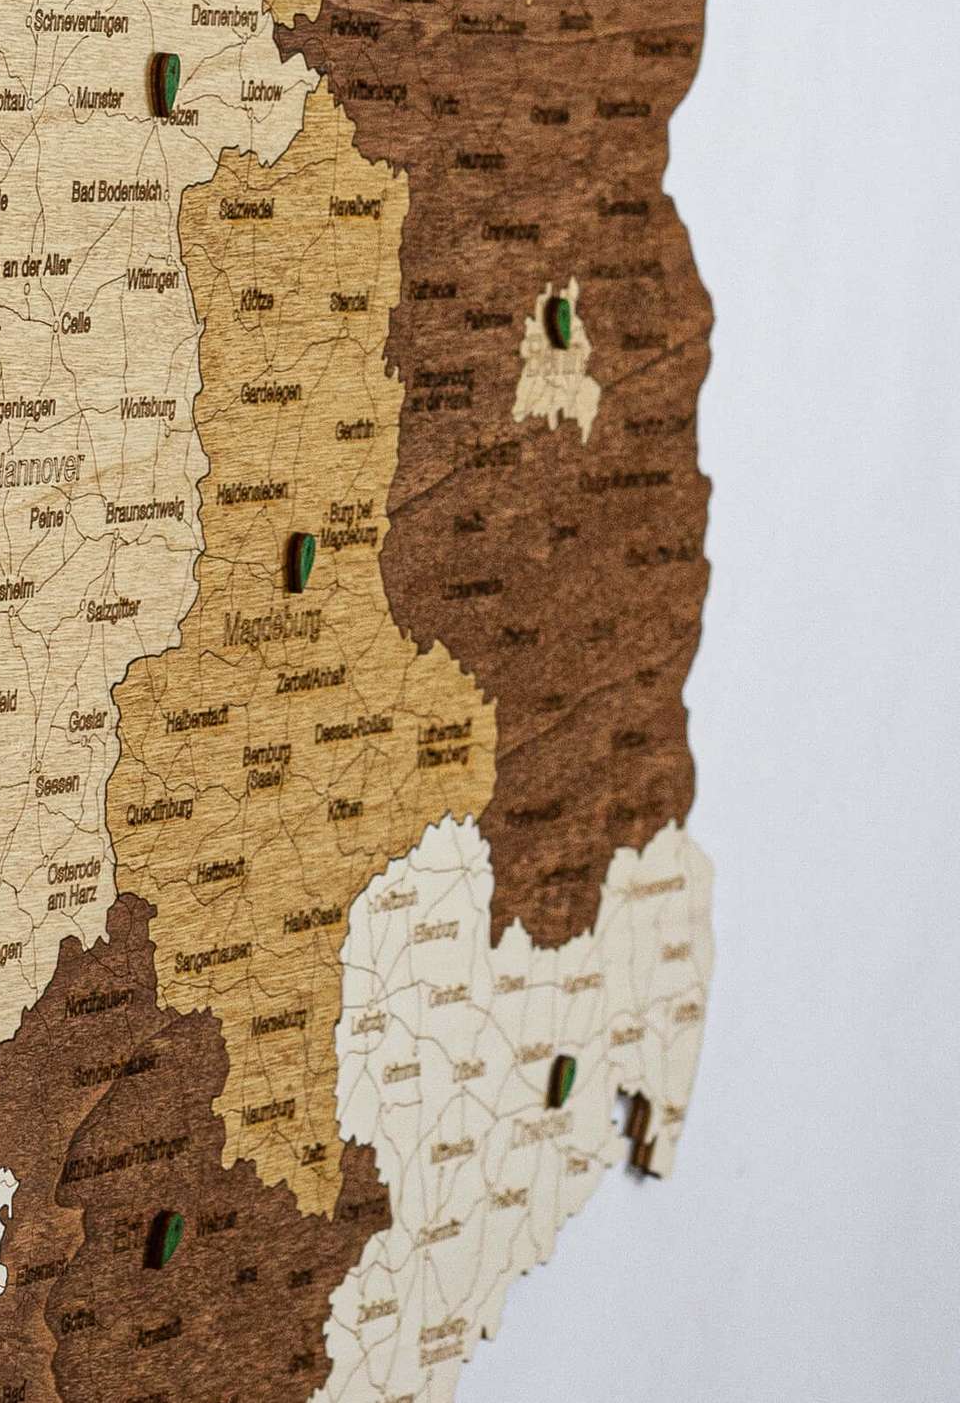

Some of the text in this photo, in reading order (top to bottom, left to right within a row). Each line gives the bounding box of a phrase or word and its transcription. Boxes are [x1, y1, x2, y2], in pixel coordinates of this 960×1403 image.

[35, 9, 129, 35] Schneverdingen
[191, 3, 258, 32] Dannenberg
[76, 86, 123, 109] Munster
[242, 80, 282, 103] Lüchow
[72, 179, 161, 203] Bad Bodenteich
[3, 258, 18, 277] an
[22, 255, 40, 277] der
[43, 255, 71, 276] Aller
[127, 267, 179, 293] Wittingen
[61, 311, 91, 334] Celle
[120, 396, 176, 421] Wolfsburg
[30, 506, 64, 530] Peine
[106, 495, 184, 524] Braunschweig
[87, 598, 141, 625] Salzgitter
[223, 607, 322, 648] Magdeburg
[69, 707, 107, 732] Goslar
[36, 773, 80, 797] Seesen
[47, 858, 101, 885] Osterode
[48, 885, 97, 910] am Harz
